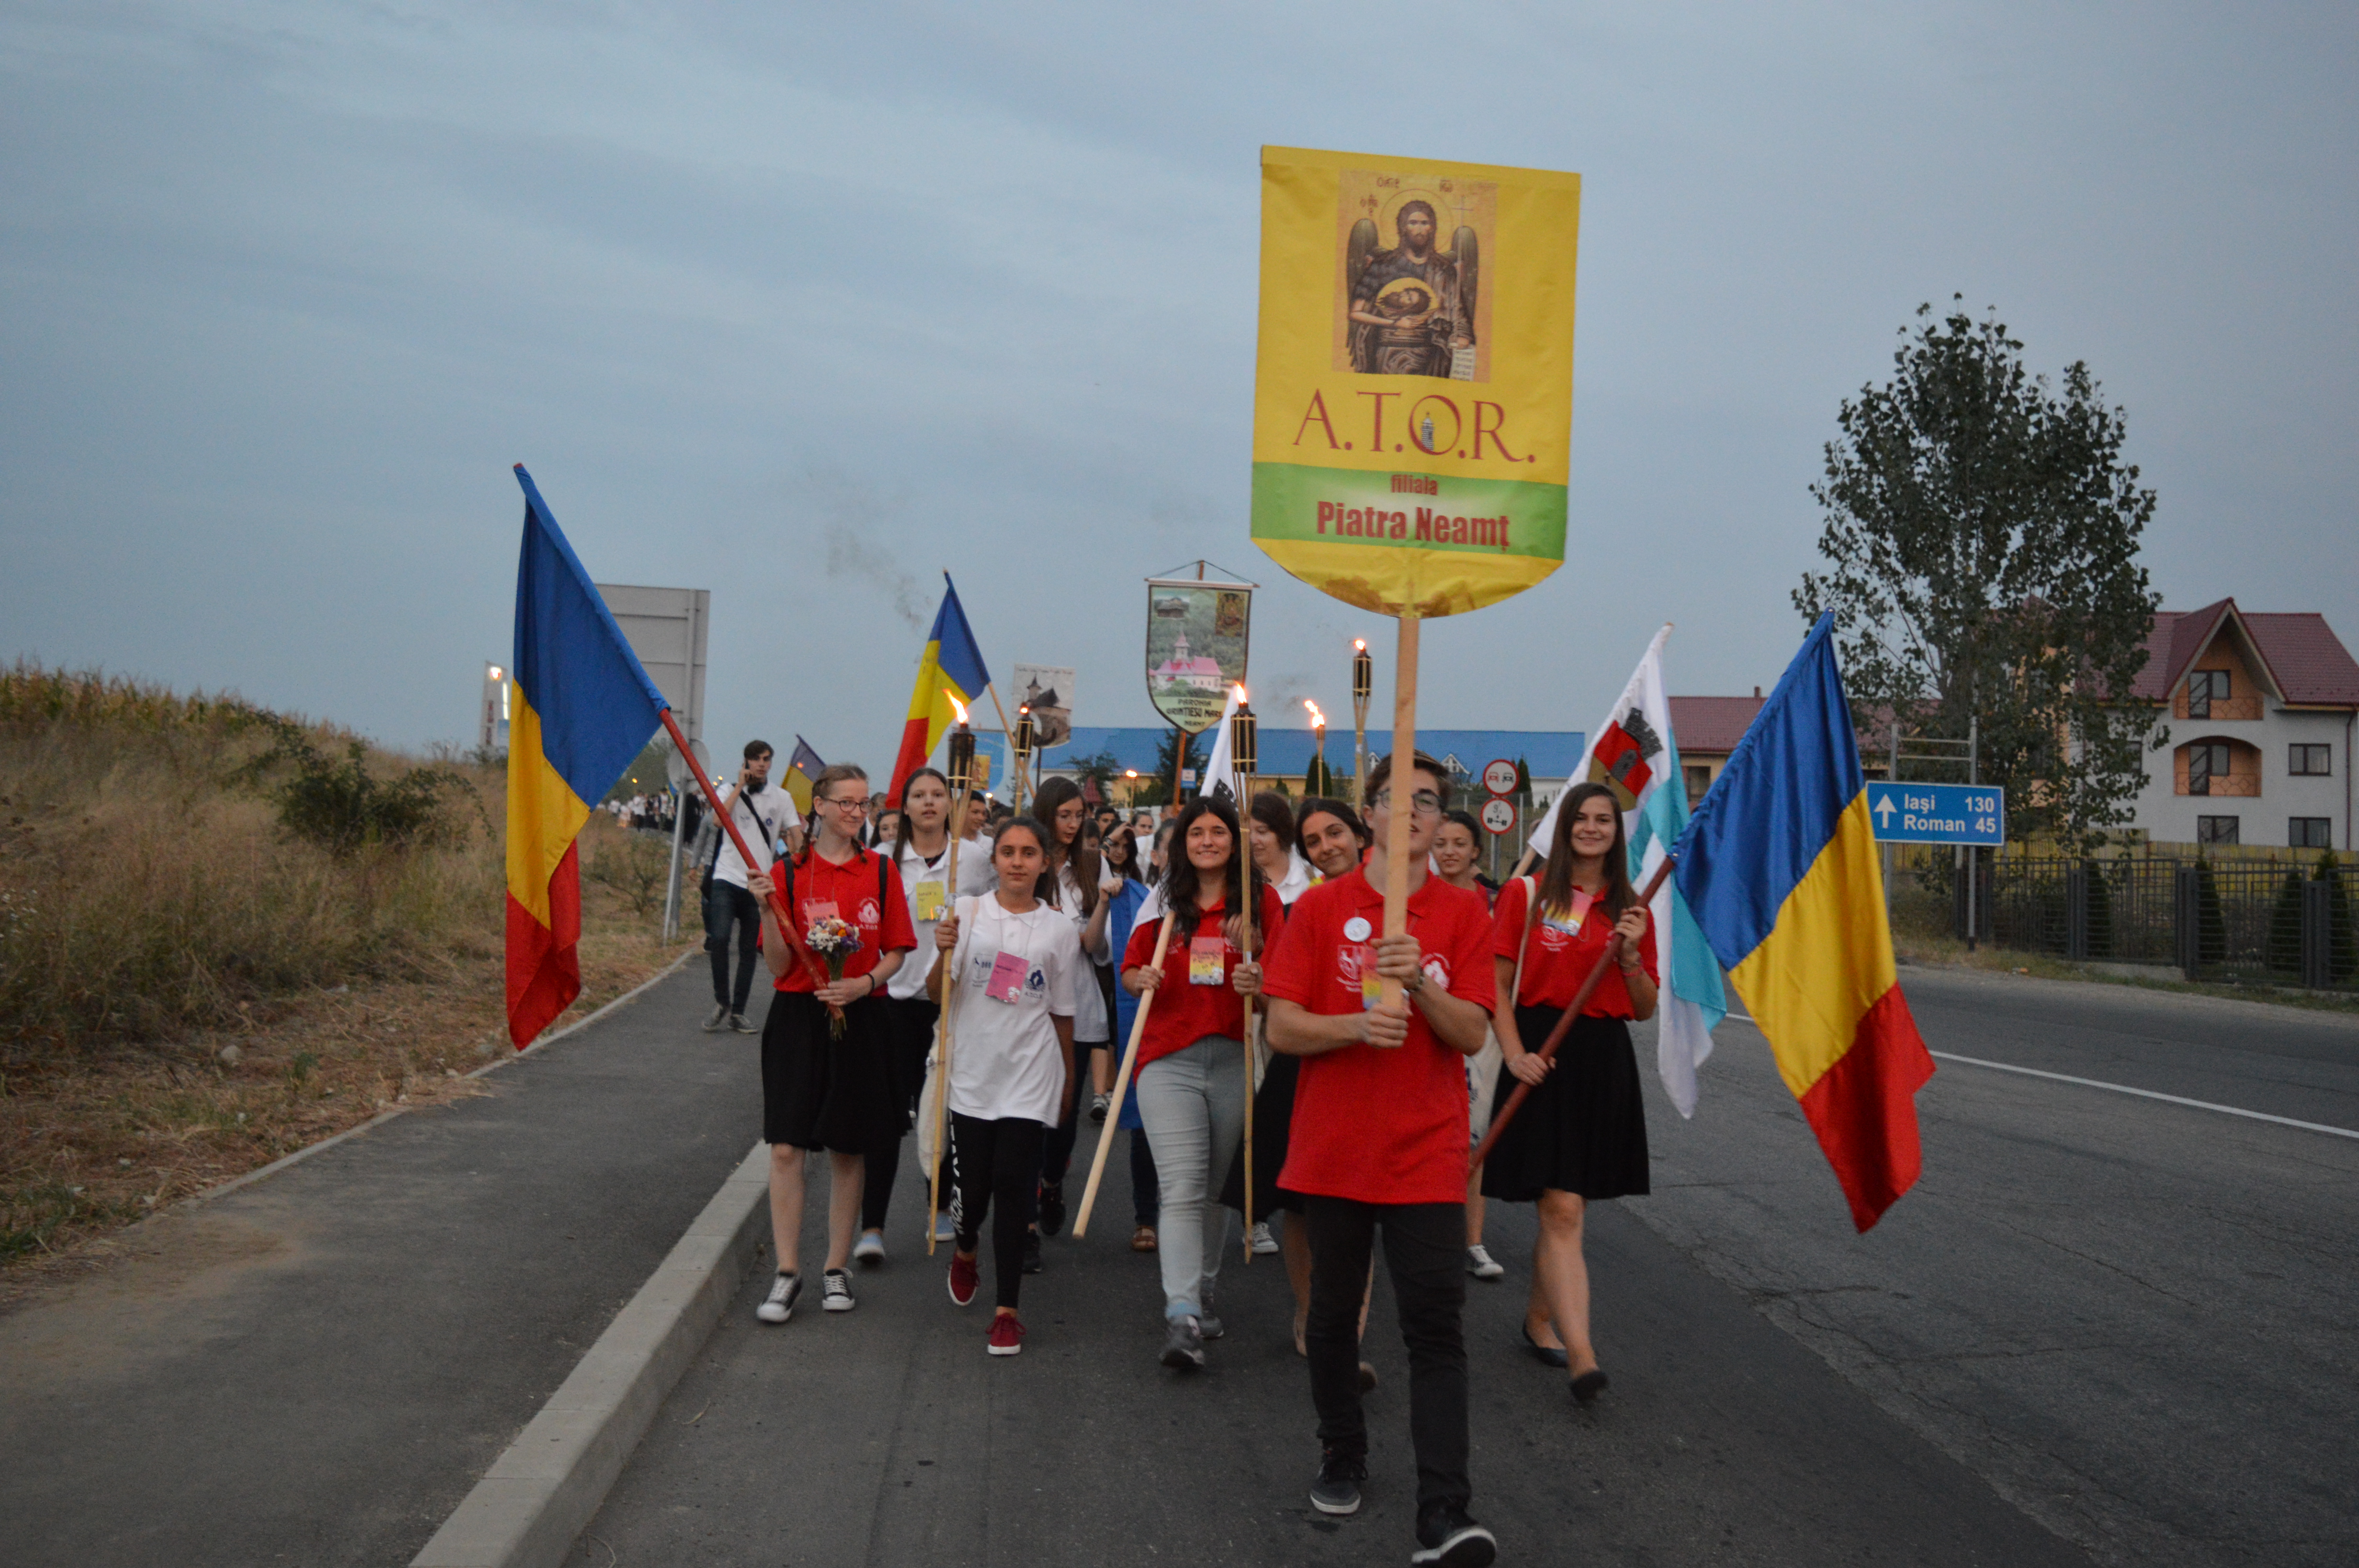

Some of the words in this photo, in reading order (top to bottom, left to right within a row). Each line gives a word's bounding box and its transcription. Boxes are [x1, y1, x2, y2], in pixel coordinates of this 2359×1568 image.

[1292, 388, 1536, 464] A.T.O.R.
[1390, 474, 1438, 496] filiala
[1317, 501, 1407, 539] Piatra
[1965, 796, 1994, 813] 130
[1904, 814, 1965, 832] Roman
[1975, 817, 1996, 833] 45
